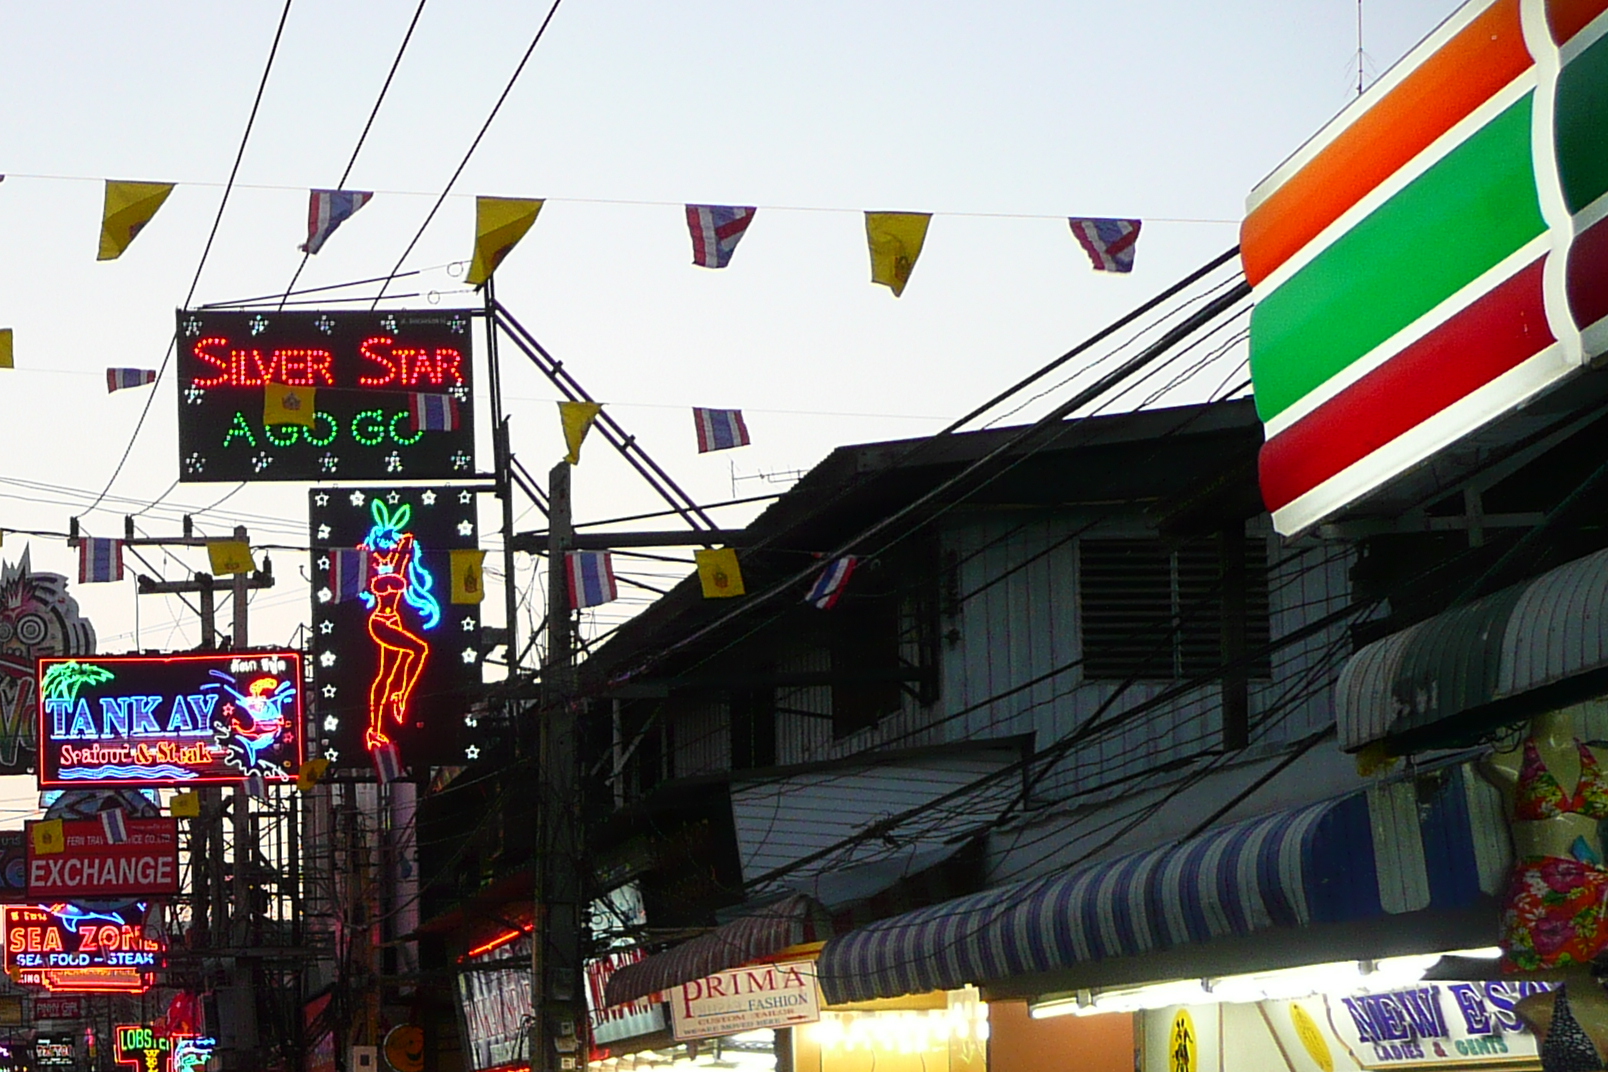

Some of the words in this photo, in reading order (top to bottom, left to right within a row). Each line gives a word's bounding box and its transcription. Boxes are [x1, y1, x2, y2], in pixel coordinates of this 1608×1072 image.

[193, 337, 333, 386] SILVER
[358, 336, 463, 385] STAR
[45, 694, 219, 740] TANKAY
[134, 744, 154, 765] &
[156, 741, 213, 764] Steak
[30, 856, 173, 888] EXCHANGE
[10, 927, 63, 952] SEA
[17, 954, 43, 966] SEA
[49, 954, 90, 966] FOOD
[107, 953, 154, 965] STEAK
[682, 967, 806, 1019] PRIMA
[748, 993, 808, 1011] FASHION
[1342, 985, 1450, 1043] NEW
[1373, 1041, 1426, 1062] LADIES
[1431, 1040, 1449, 1059] &
[1453, 1035, 1510, 1058] GENTS
